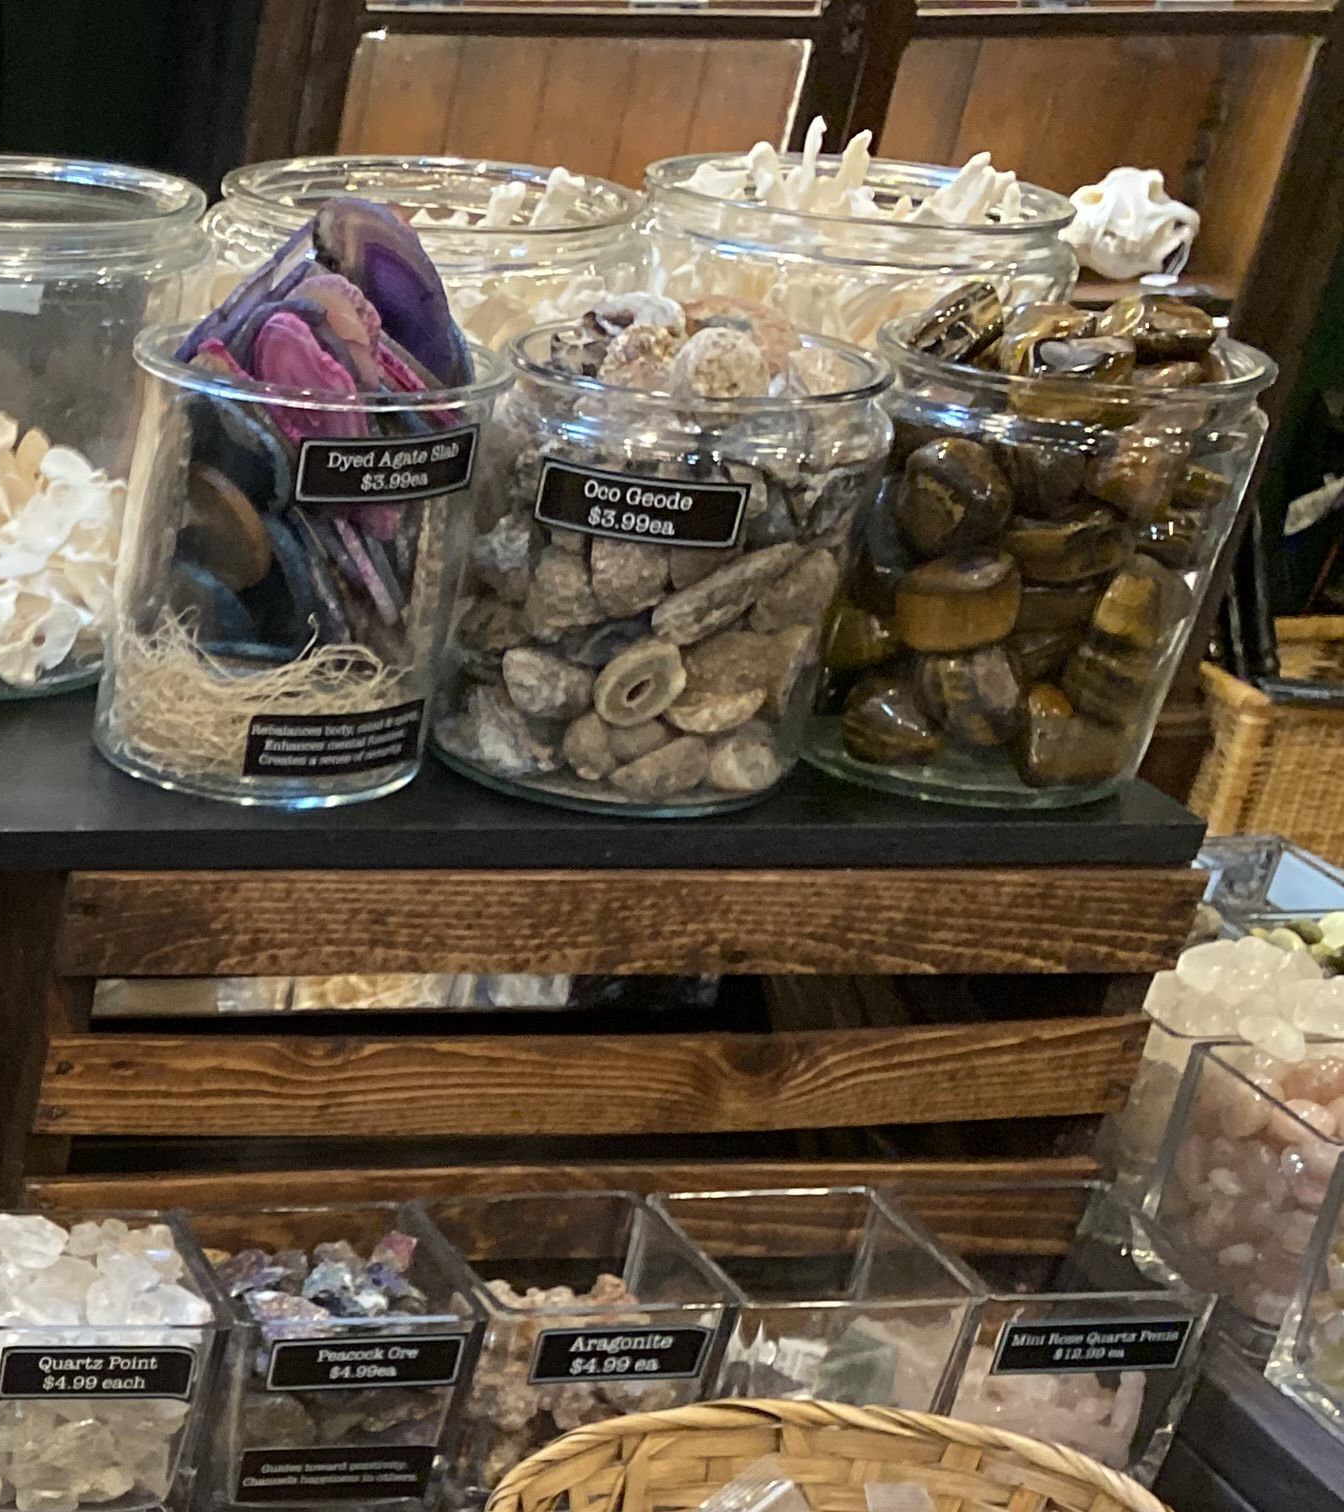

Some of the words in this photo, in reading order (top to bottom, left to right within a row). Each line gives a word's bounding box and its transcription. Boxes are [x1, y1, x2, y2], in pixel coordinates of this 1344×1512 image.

[327, 452, 373, 471] Dyed
[378, 450, 428, 469] Agate
[431, 443, 459, 461] Slab
[361, 472, 428, 492] $3.99ea
[584, 480, 620, 502] Oco
[626, 487, 693, 511] Geode
[588, 505, 675, 536] $3.99ea
[569, 1335, 674, 1353] Aragonite
[317, 1347, 384, 1362] Peacock
[388, 1346, 420, 1360] Ore
[38, 1356, 104, 1373] Quartz
[108, 1356, 158, 1370] Point
[329, 1365, 397, 1380] $4.99ea
[569, 1357, 631, 1375] $4.99
[634, 1358, 660, 1371] ea
[43, 1375, 97, 1391] $4.99
[102, 1376, 146, 1390] each
